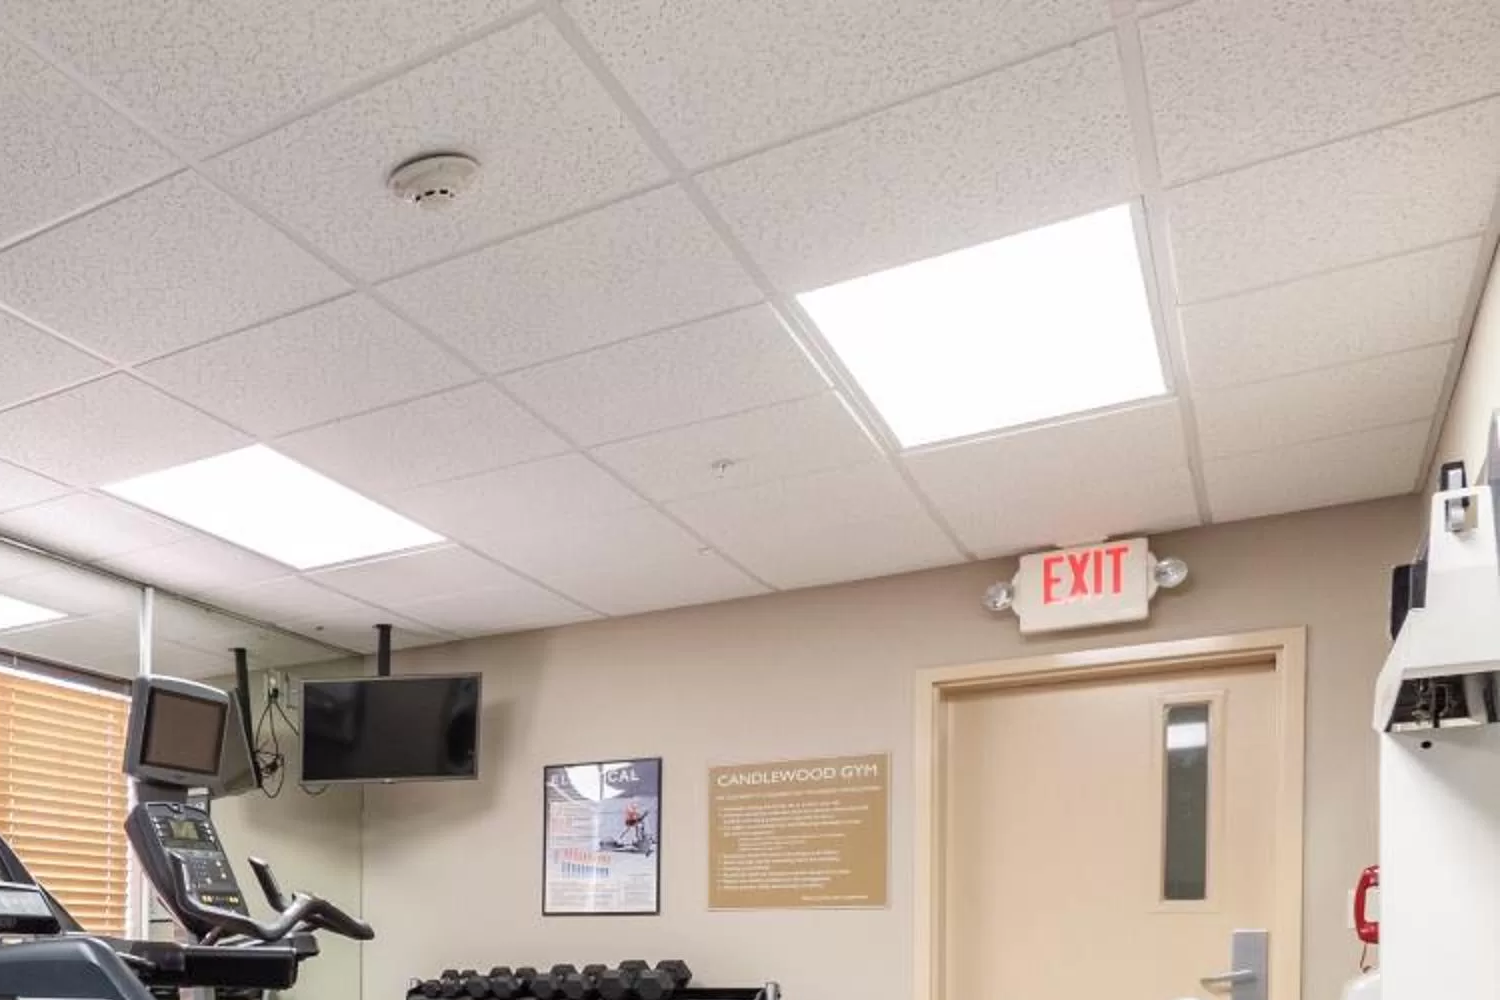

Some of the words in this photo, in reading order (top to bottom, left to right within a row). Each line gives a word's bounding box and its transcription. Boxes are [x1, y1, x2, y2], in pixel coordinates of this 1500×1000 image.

[1043, 547, 1129, 604] EXIT
[717, 766, 837, 787] CANDLEWOOD
[841, 763, 878, 779] GYM
